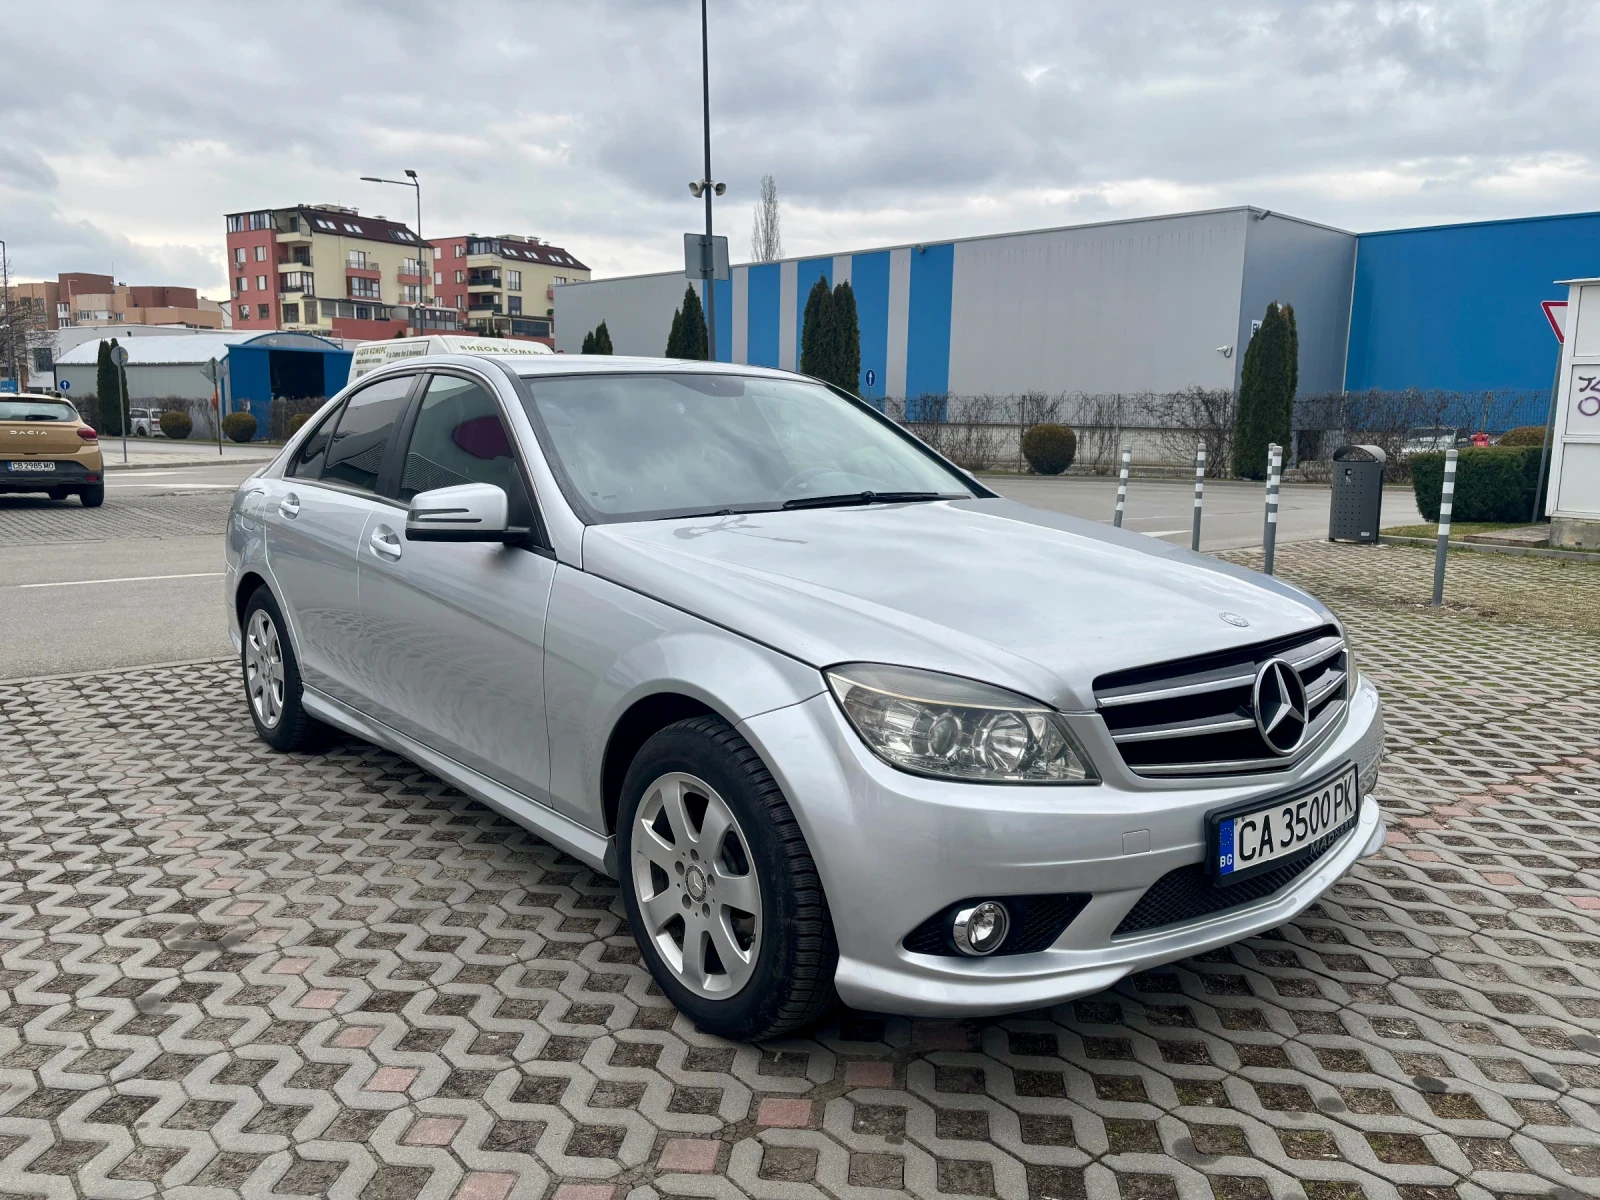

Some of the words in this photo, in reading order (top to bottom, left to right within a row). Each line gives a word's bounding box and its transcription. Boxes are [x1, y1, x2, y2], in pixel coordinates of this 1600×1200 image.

[1239, 815, 1274, 861] CA
[1280, 790, 1331, 848] 3500
[1334, 775, 1353, 823] PK
[1220, 854, 1233, 868] BG
